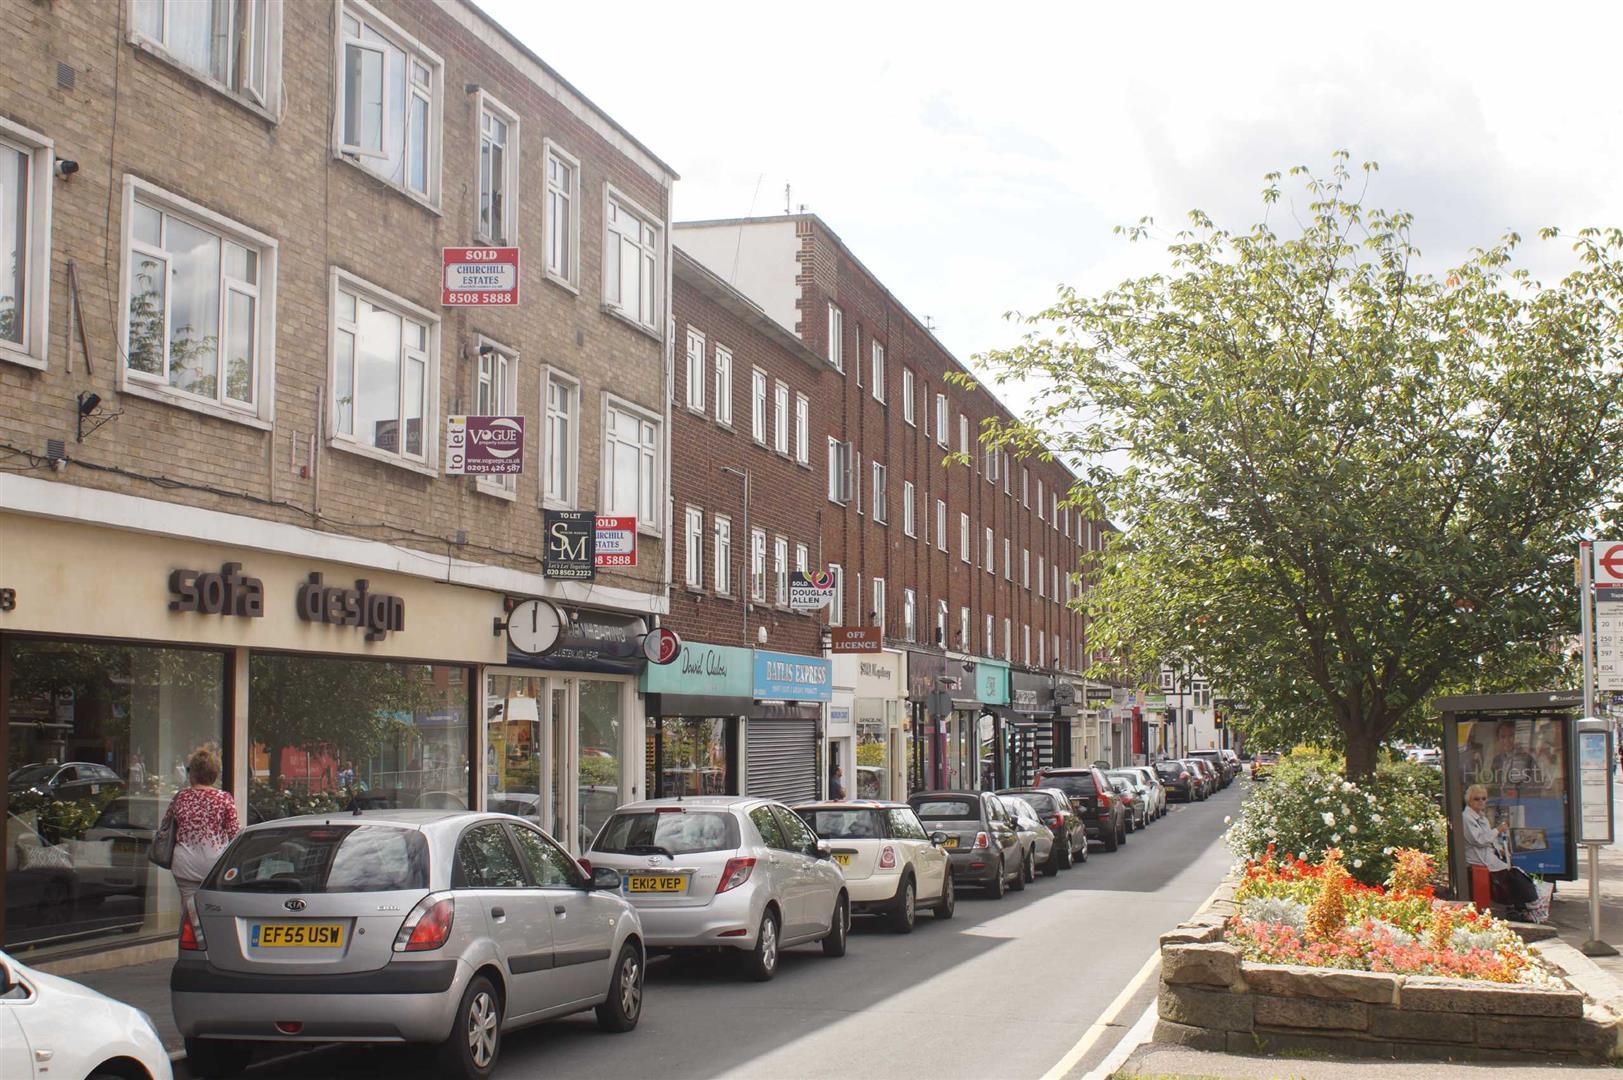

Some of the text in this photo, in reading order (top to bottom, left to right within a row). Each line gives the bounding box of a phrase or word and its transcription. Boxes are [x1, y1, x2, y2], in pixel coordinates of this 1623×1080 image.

[465, 250, 498, 260] SOLD
[456, 265, 505, 274] CHURCHILL
[462, 276, 499, 284] ESTATES
[449, 293, 511, 303] 8508 5888
[468, 429, 517, 445] VOGUE
[448, 428, 464, 470] to let
[467, 464, 521, 473] 02031 426 587
[606, 556, 631, 565] 5888
[792, 589, 833, 597] DOUGLAS
[169, 562, 405, 642] sofa design
[846, 631, 866, 639] OFF
[835, 641, 878, 650] LICENCE
[795, 664, 827, 685] EXPRESS
[1463, 763, 1556, 790] Honestly
[632, 878, 681, 889] EK12 VEP
[286, 900, 306, 909] KIA
[263, 927, 304, 943] EF55
[308, 927, 340, 943] USW
